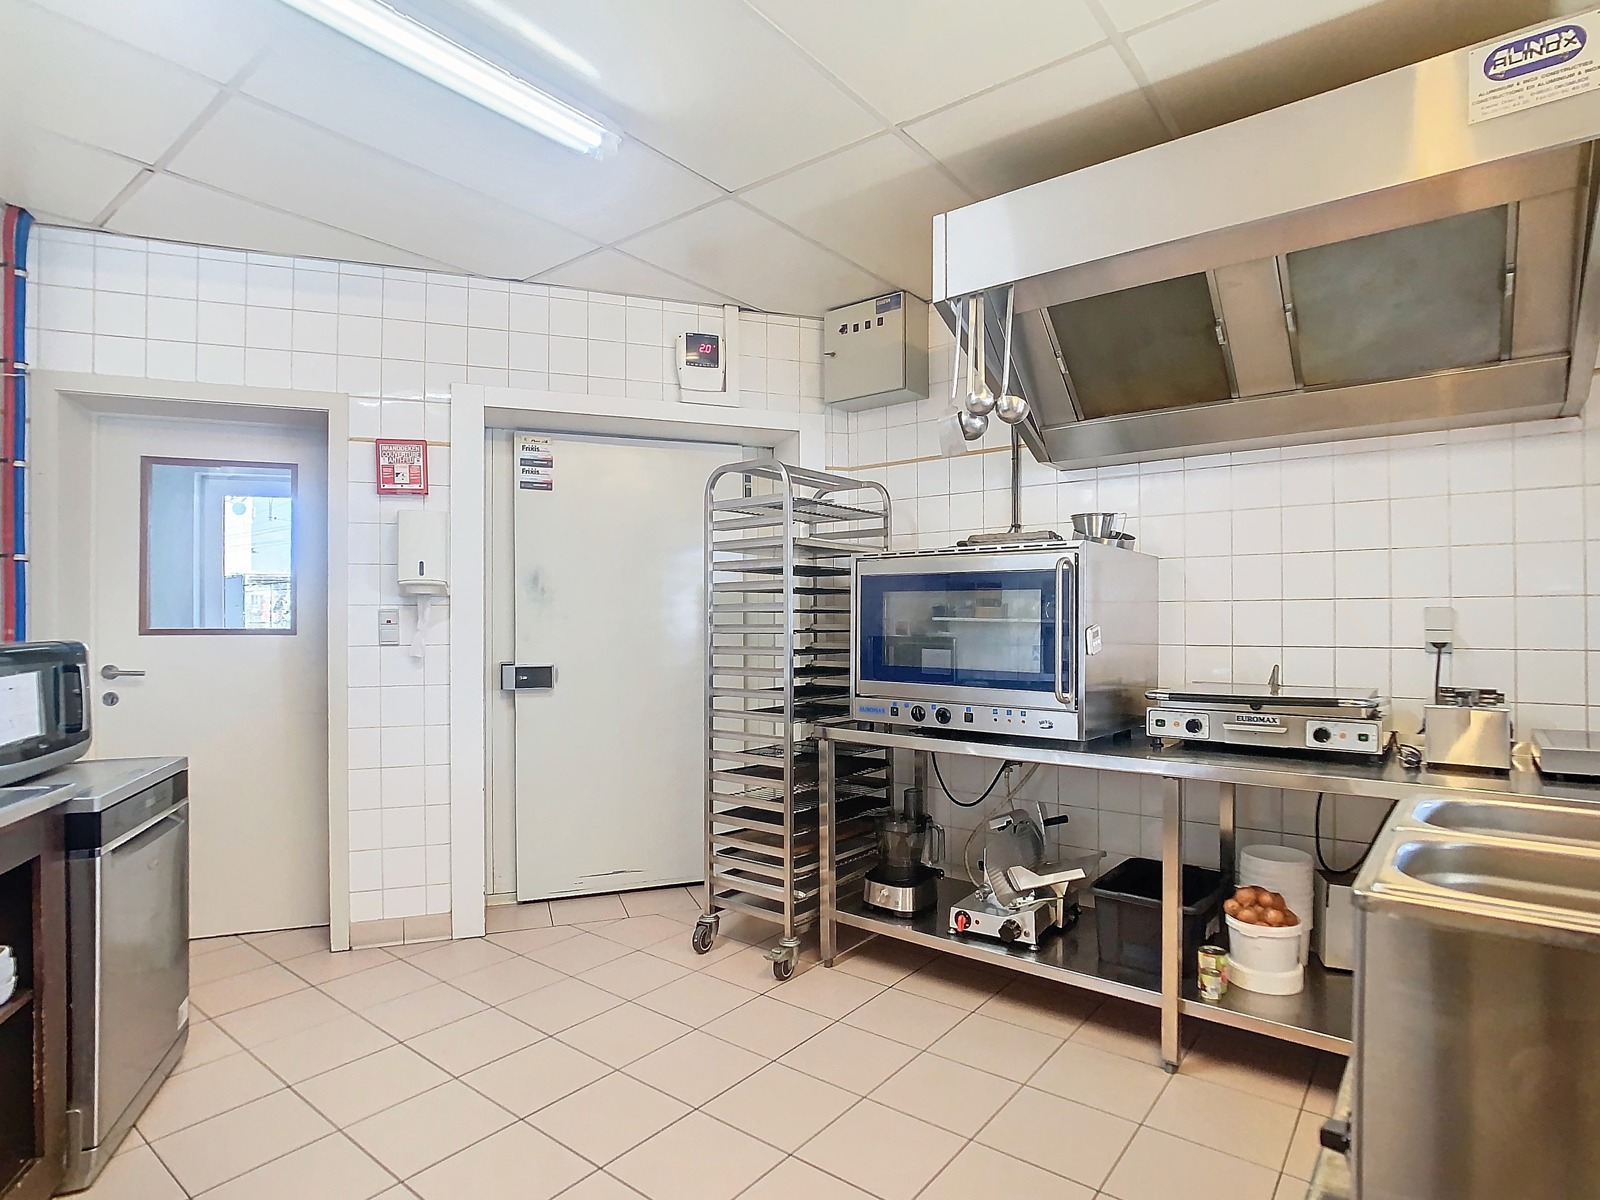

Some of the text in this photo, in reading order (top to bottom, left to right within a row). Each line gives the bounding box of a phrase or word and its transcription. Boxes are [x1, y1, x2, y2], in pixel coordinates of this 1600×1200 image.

[1492, 31, 1580, 72] ALINOX
[1478, 83, 1514, 97] ALUMINIUM
[1540, 60, 1593, 79] CONSTRUCTIES
[1537, 72, 1576, 87] ALUMINIUM
[699, 343, 712, 354] 2.0
[381, 451, 421, 459] COUVERTURE
[1236, 715, 1278, 724] EUROMAX
